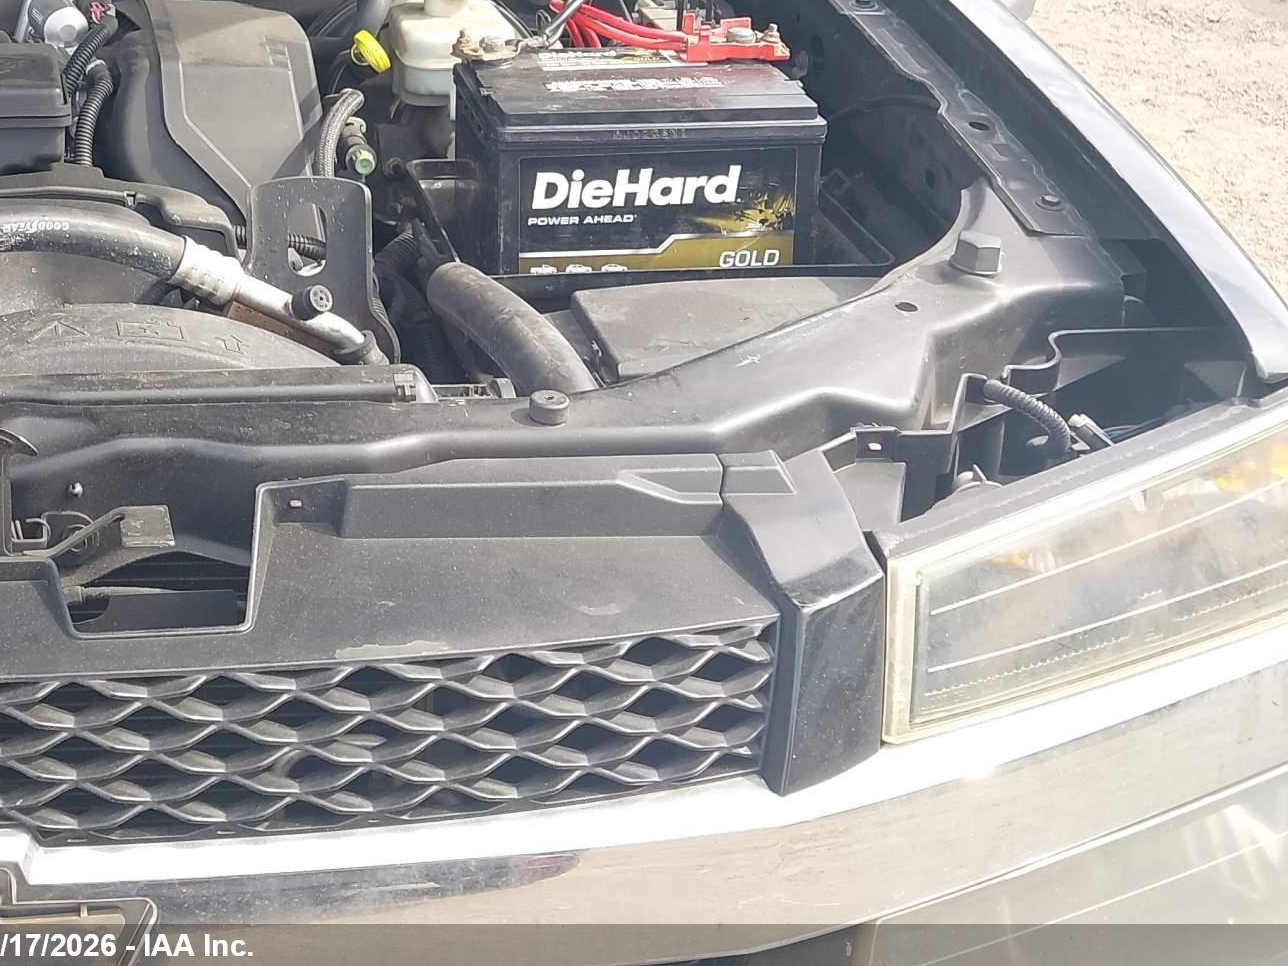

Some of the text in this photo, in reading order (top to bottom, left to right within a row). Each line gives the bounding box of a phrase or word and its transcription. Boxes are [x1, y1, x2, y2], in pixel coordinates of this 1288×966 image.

[531, 164, 742, 210] DieHard
[1, 219, 70, 234] GOODYEAR
[527, 214, 635, 227] POWER AHEAD
[718, 249, 780, 268] GOLD
